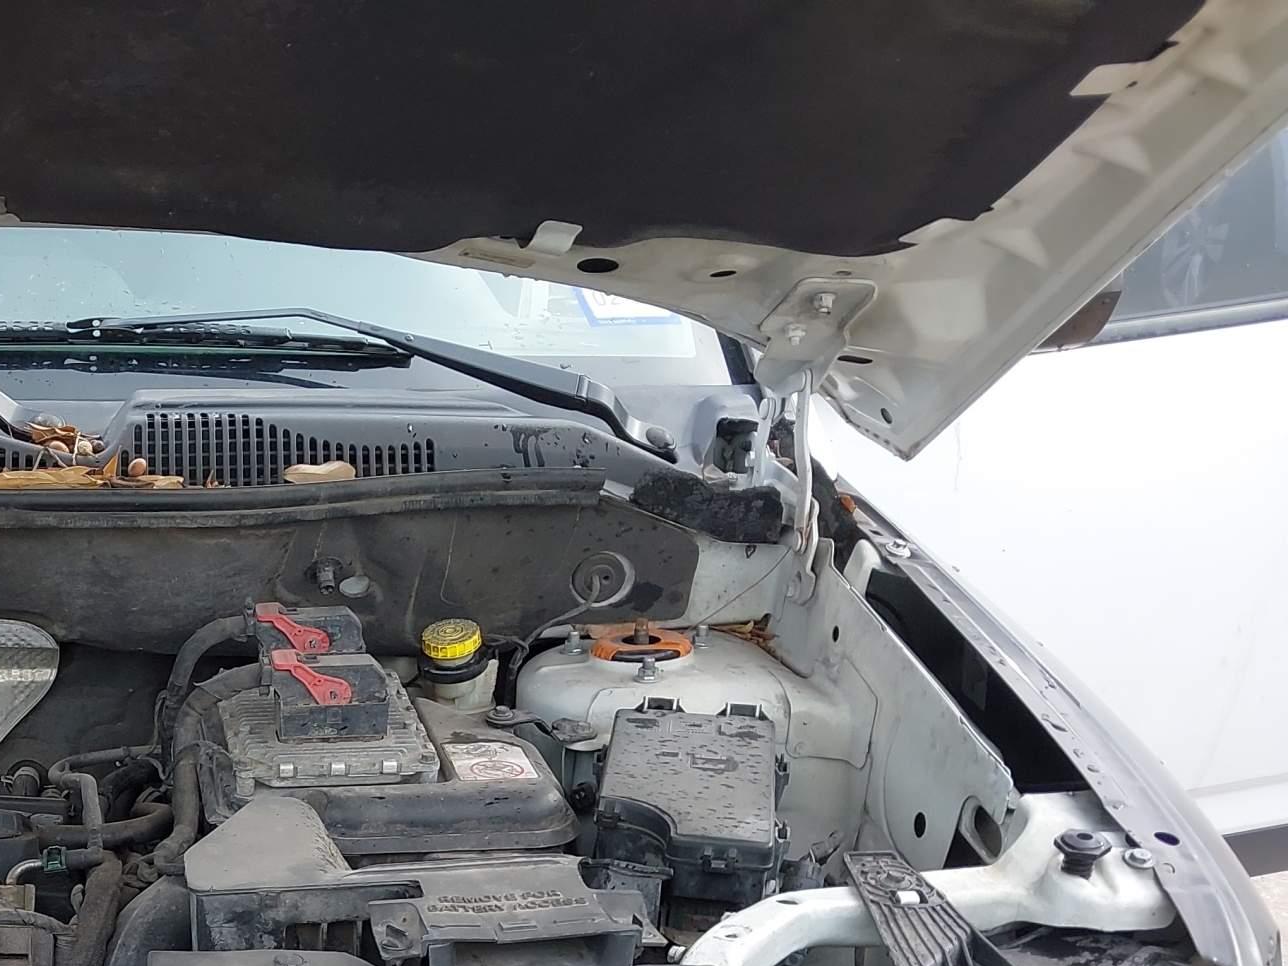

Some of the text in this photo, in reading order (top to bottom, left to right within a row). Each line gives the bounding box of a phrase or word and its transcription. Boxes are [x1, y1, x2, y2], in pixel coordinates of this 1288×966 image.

[438, 889, 562, 903] REMOVE FOR
[427, 897, 587, 913] BATTERY ACCESS
